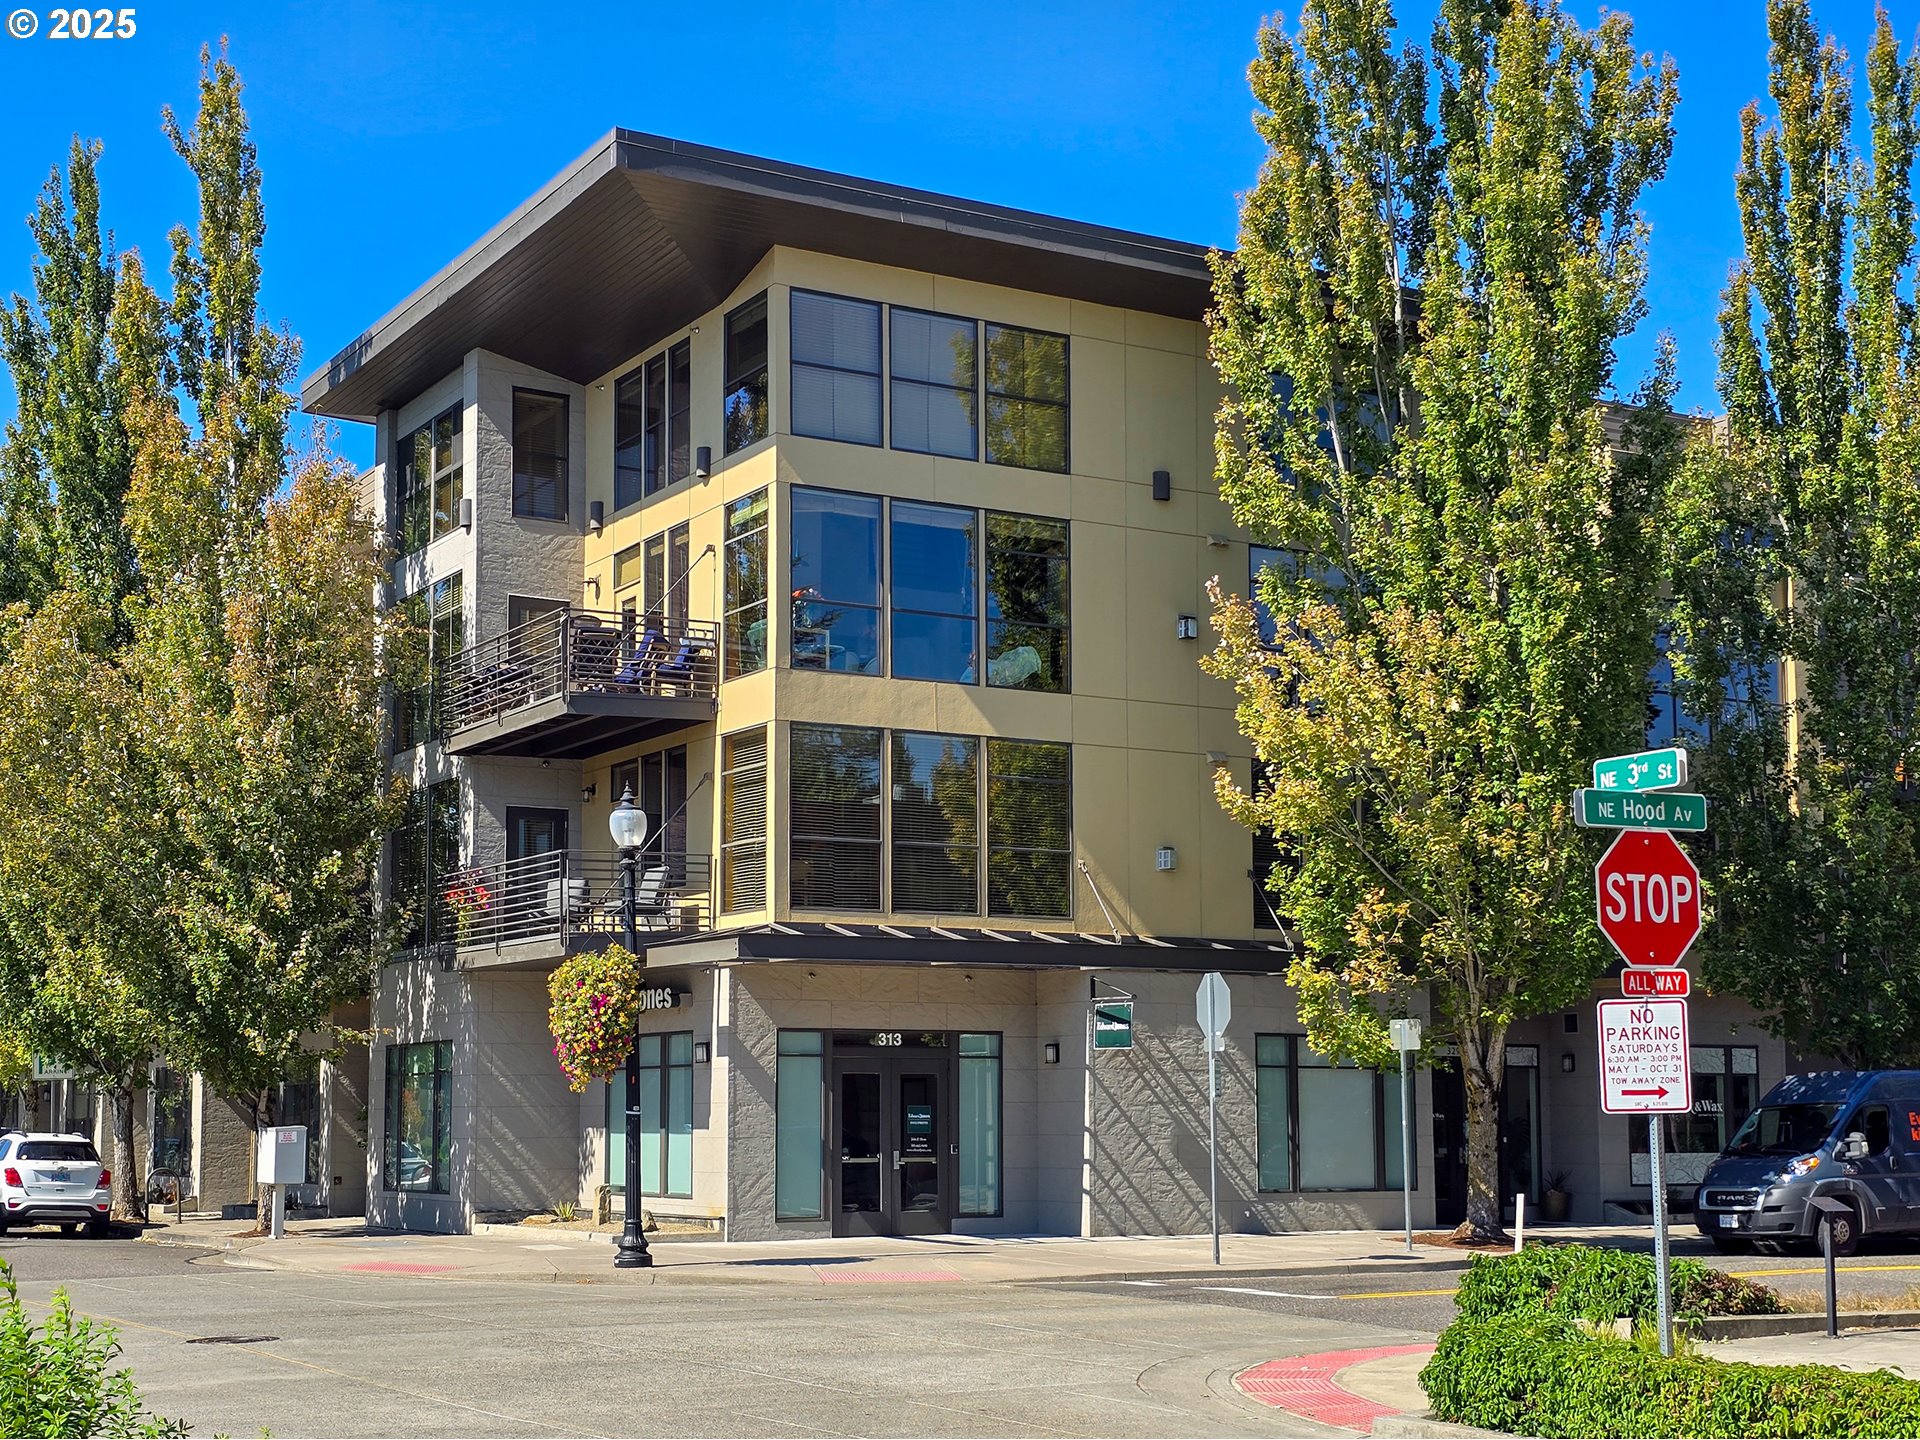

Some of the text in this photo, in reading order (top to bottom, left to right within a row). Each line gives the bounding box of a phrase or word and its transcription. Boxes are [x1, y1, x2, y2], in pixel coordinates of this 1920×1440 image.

[1600, 762, 1673, 788] NE 3rd St
[1598, 799, 1692, 822] NE Hood Av
[1605, 872, 1693, 924] STOP
[1629, 975, 1682, 991] ALL WAY
[639, 987, 672, 1012] ones
[1630, 1009, 1654, 1024] NO
[878, 1033, 902, 1046] 313
[1607, 1026, 1680, 1041] PARKING
[1610, 1043, 1678, 1054] SATURDAYS
[1608, 1065, 1630, 1074] MAY
[1635, 1065, 1638, 1073] 1
[1650, 1064, 1668, 1073] OCT
[1673, 1064, 1682, 1073] 31
[1660, 1076, 1681, 1084] ZONE
